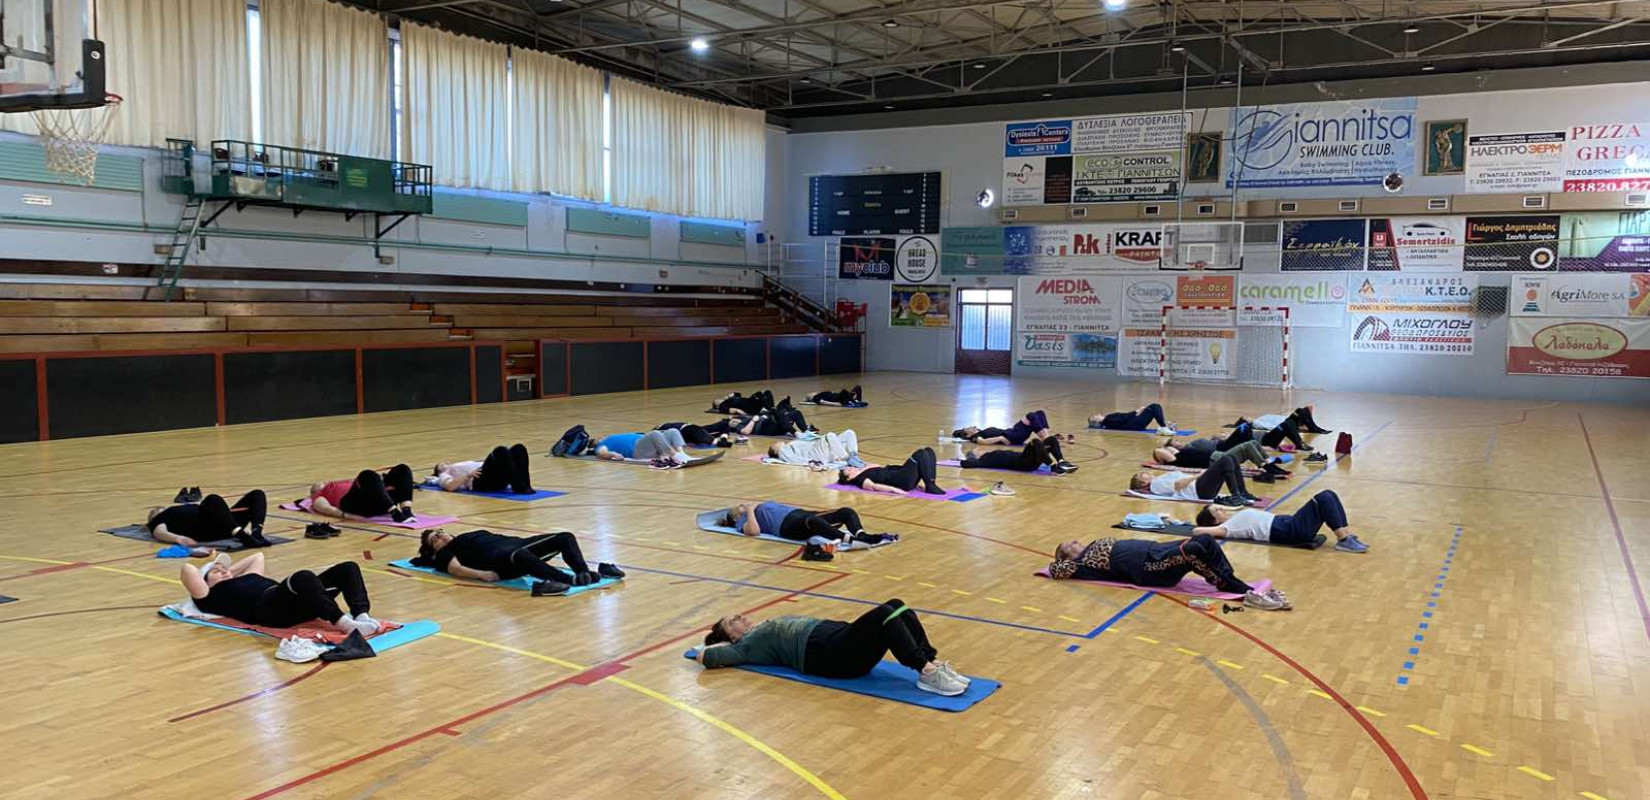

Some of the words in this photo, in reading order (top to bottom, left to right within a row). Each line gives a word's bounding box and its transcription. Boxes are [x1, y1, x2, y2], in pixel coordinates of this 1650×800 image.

[1077, 119, 1117, 130] ΔΥΣΛΕΞΙΑ
[1571, 124, 1642, 140] PIZZA
[1299, 144, 1357, 158] SWIMMING
[1362, 143, 1394, 156] CLUB.
[1123, 156, 1169, 166] CONTROL
[1118, 168, 1180, 178] ΓΙΑΝΝΙΤΣΩΝ
[1396, 237, 1456, 246] Semertzidis
[908, 248, 926, 258] BREAD
[908, 259, 926, 268] HOUSE
[1036, 279, 1096, 294] MEDIA
[1064, 296, 1101, 304] STROM
[1550, 288, 1610, 302] AgriMore
[1393, 319, 1473, 328] ΜΙΧΟΓΛΟΥ
[1024, 335, 1064, 351] Oasis
